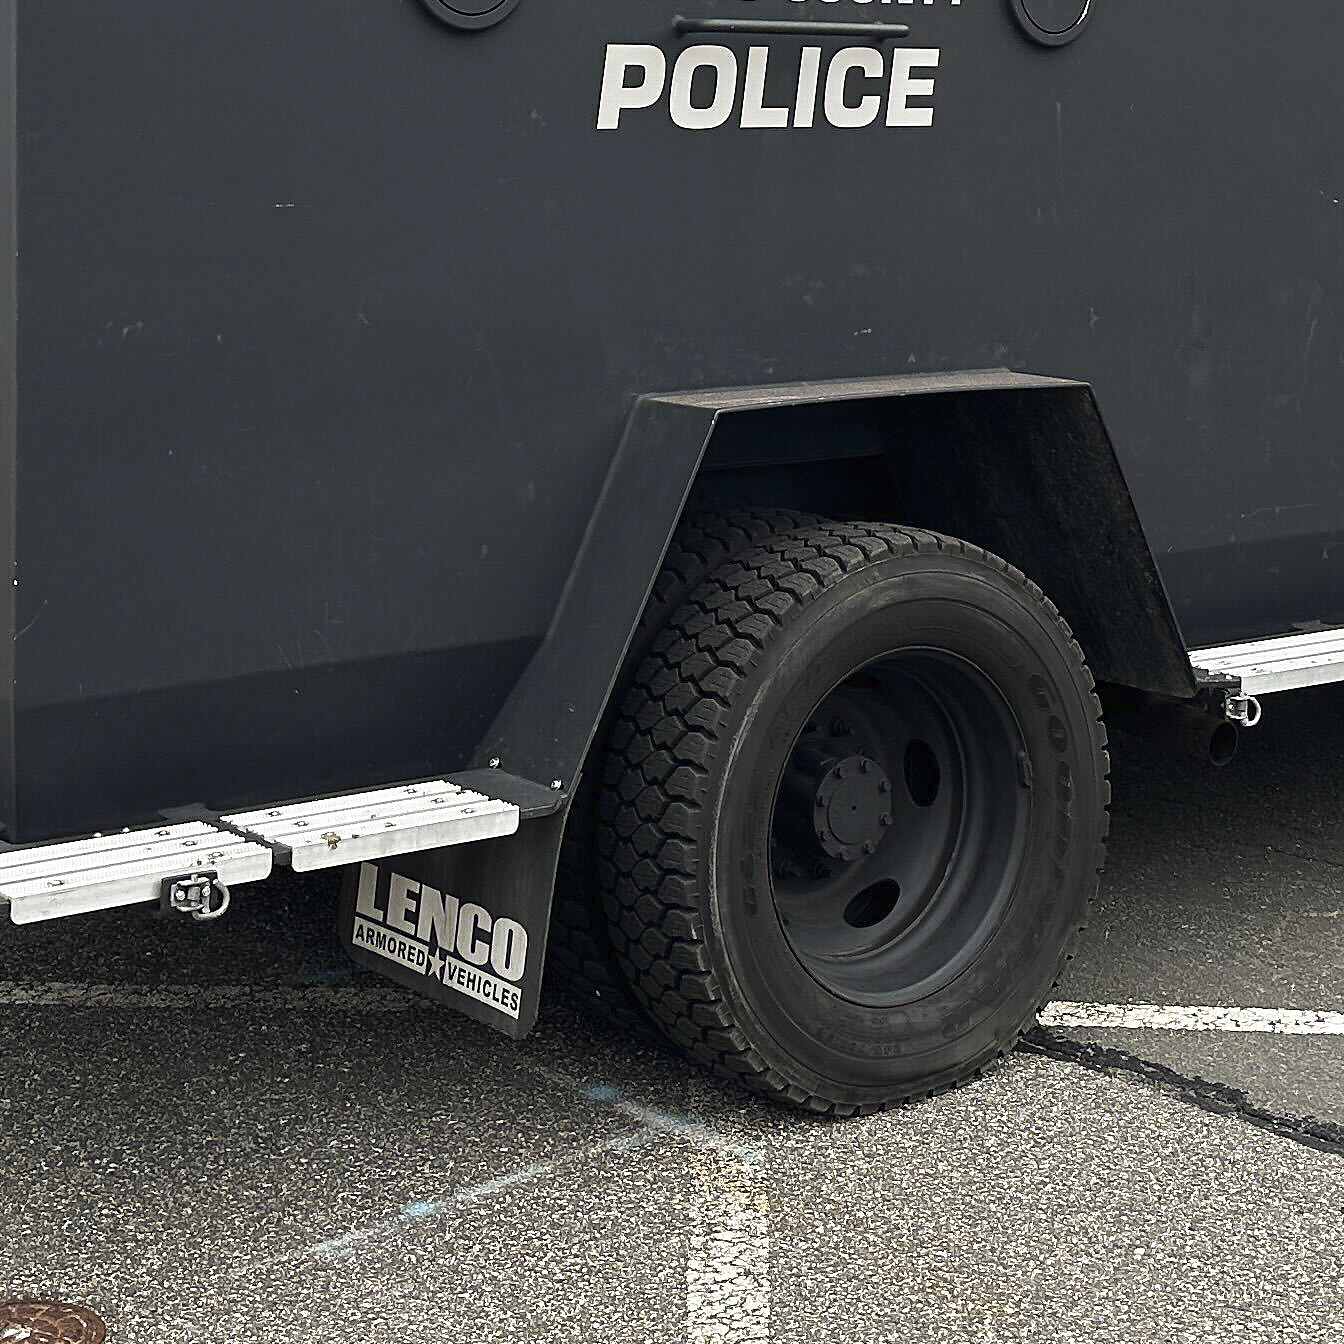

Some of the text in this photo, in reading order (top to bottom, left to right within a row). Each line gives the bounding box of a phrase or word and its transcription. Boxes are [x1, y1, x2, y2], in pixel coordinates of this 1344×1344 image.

[596, 43, 941, 131] POLICE
[354, 922, 520, 1012] ARMORED VEHICLES
[355, 861, 529, 983] LENCO
